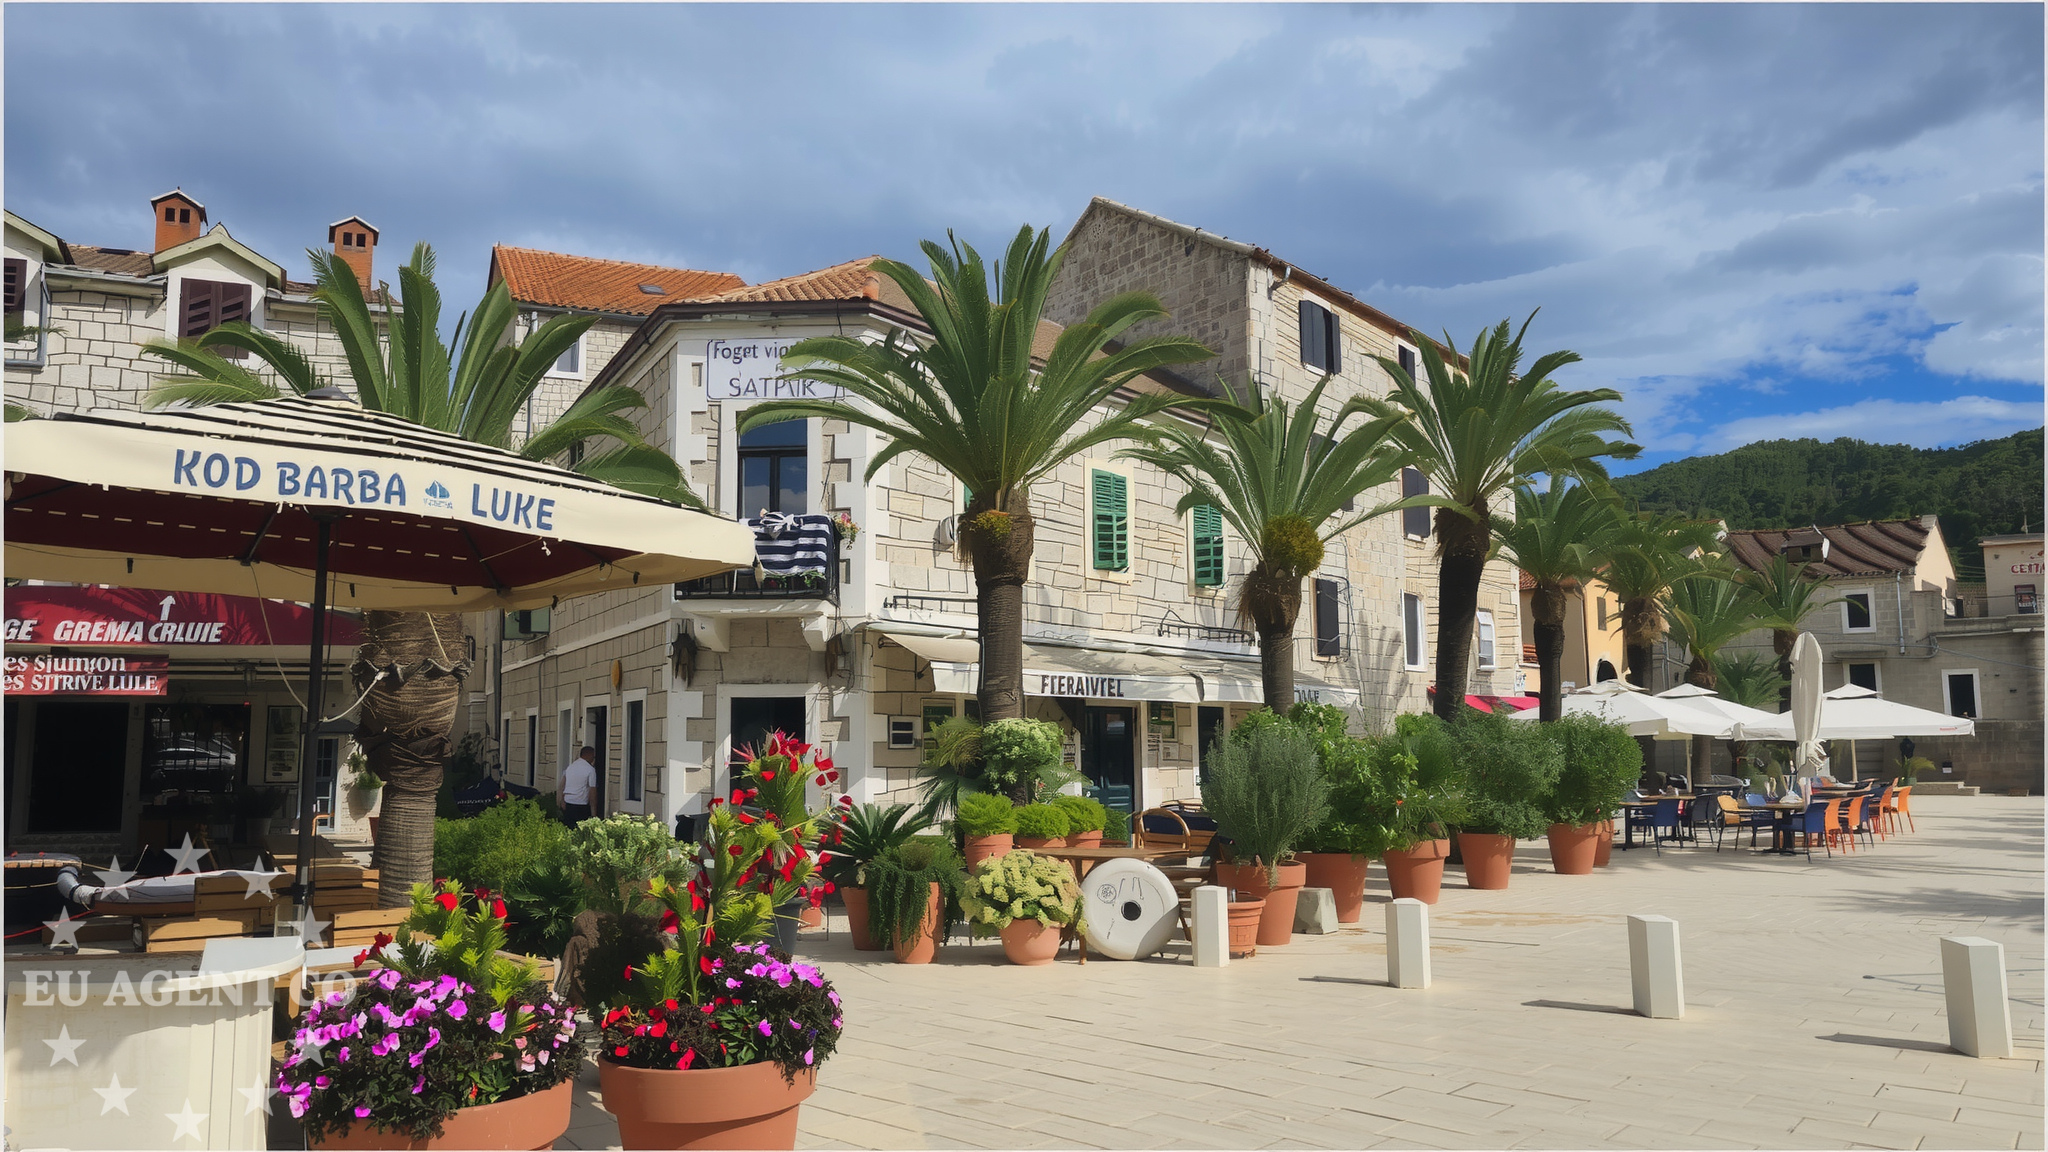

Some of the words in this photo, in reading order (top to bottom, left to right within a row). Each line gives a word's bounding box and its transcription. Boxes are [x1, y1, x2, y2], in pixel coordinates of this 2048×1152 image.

[174, 449, 261, 491] KOD
[277, 462, 406, 507] BARBA
[471, 483, 555, 531] LUKE
[53, 619, 144, 643] GREMA
